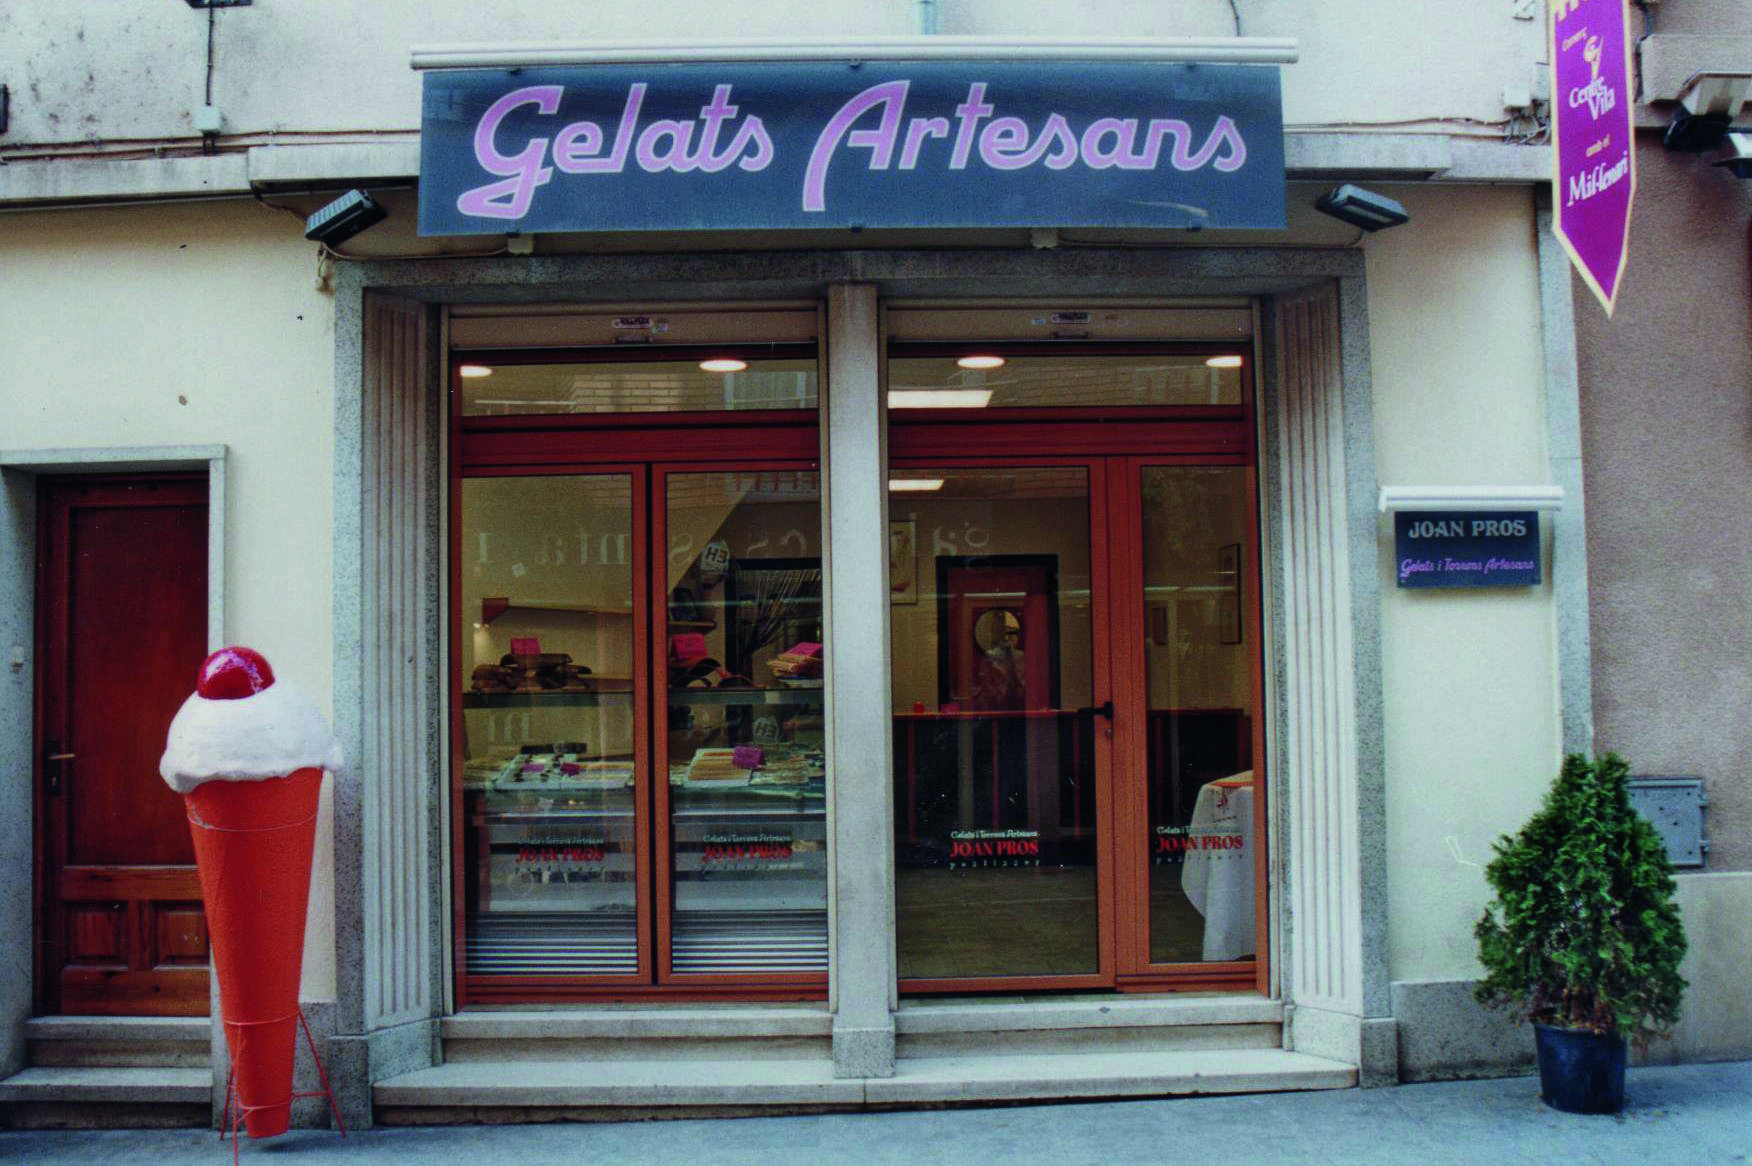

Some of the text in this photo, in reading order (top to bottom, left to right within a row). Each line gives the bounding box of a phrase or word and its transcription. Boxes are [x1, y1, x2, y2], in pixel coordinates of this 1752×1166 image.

[457, 79, 1248, 220] Gelats Artesans
[1408, 519, 1527, 538] JOAN PROS
[949, 840, 1040, 859] JOAN PROS
[1202, 835, 1245, 851] PROS
